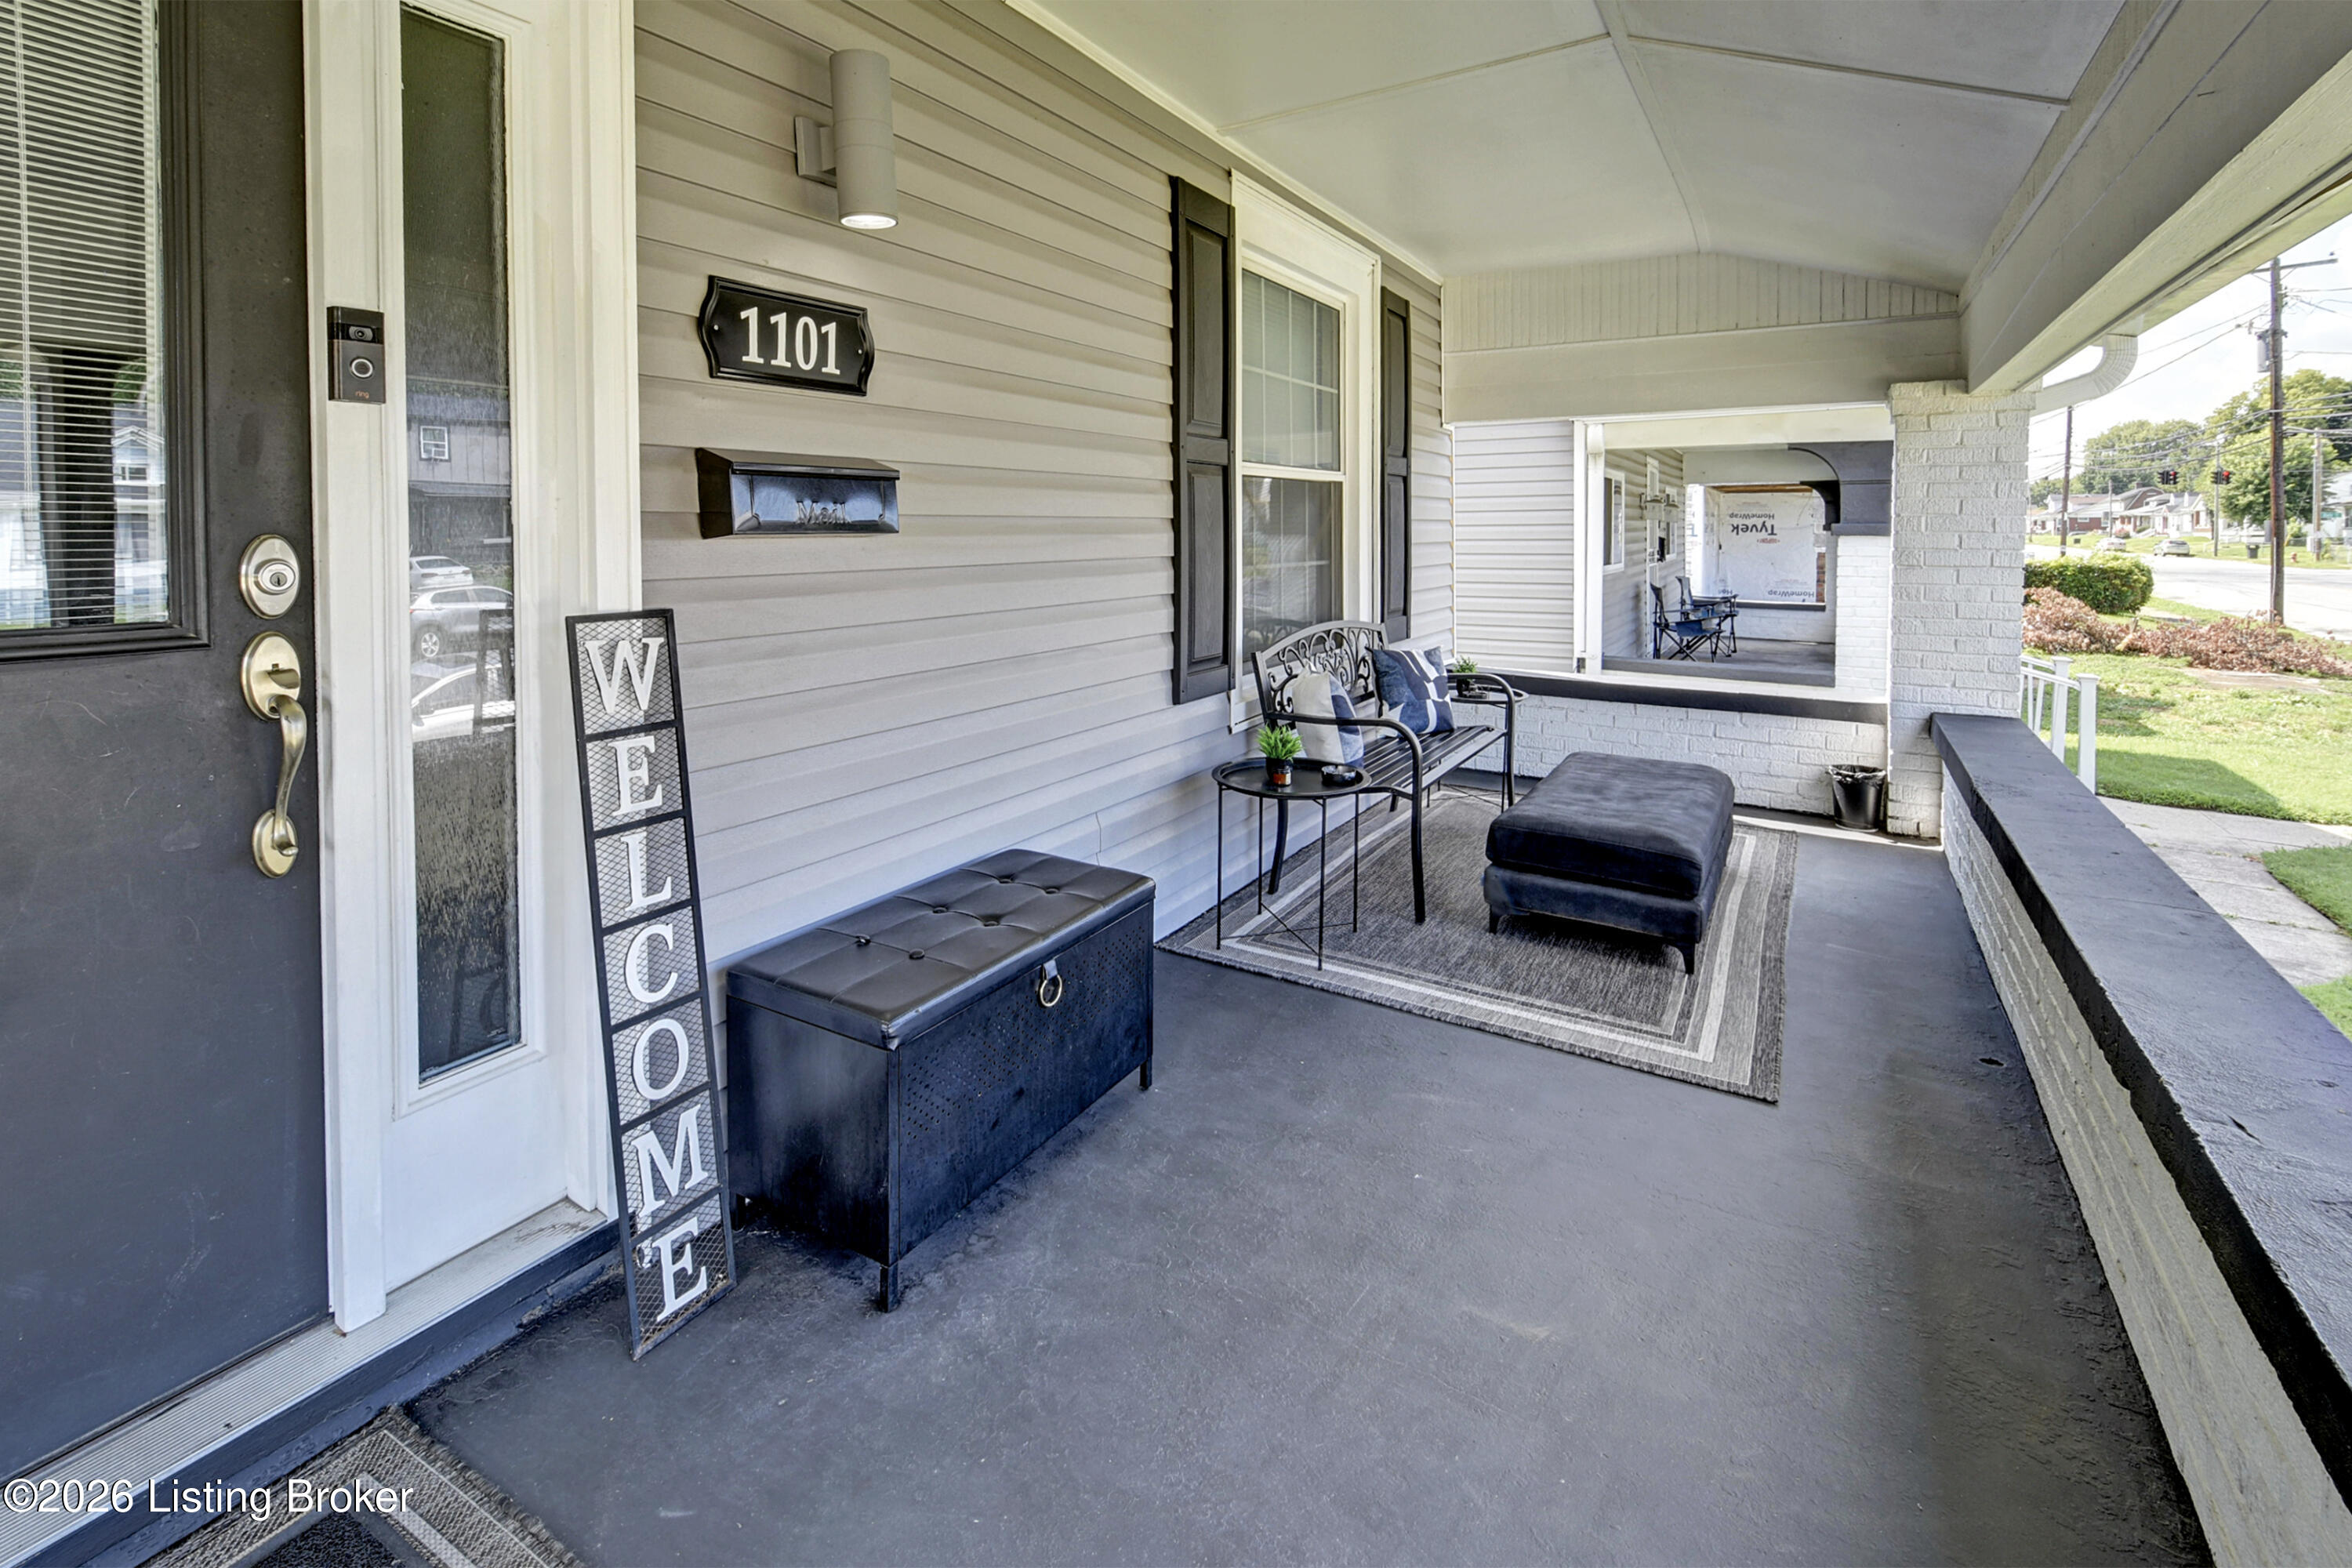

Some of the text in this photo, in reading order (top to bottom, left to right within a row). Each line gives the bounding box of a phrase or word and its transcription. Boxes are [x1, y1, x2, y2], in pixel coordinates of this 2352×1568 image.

[739, 306, 841, 376] 1101
[795, 500, 851, 524] Mail
[1731, 521, 1777, 535] Tyvek
[583, 637, 709, 1323] WELCOME
